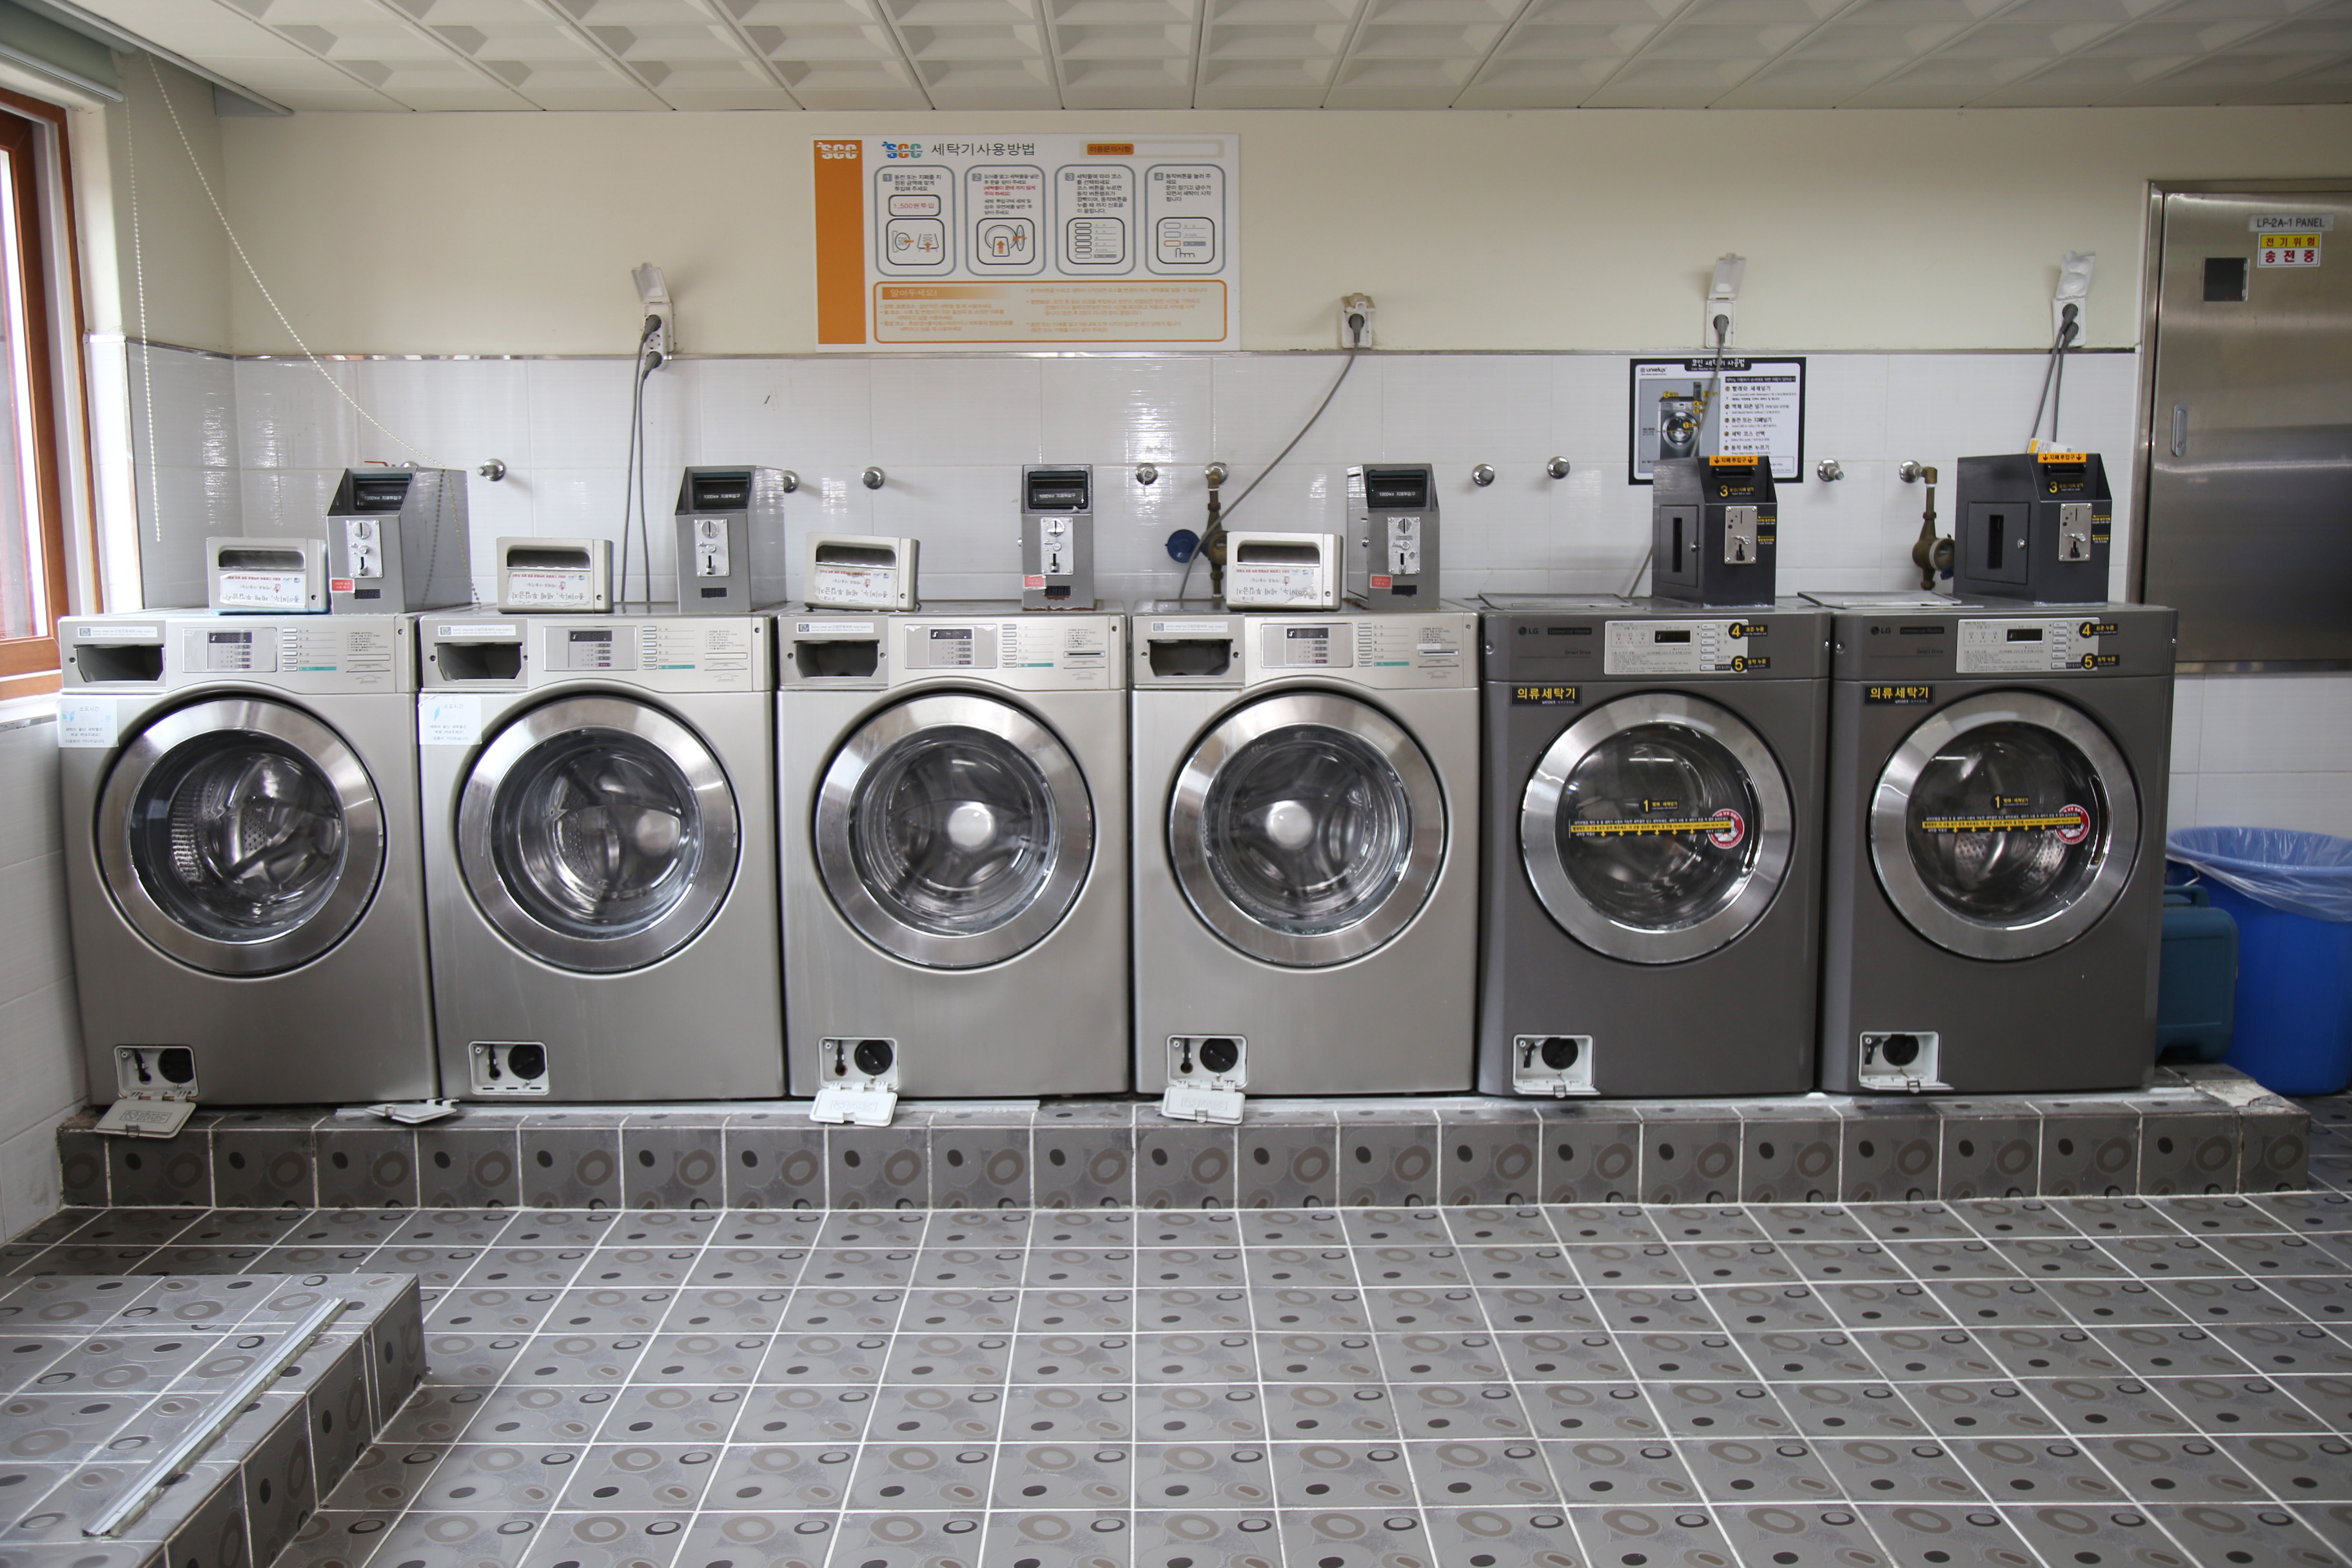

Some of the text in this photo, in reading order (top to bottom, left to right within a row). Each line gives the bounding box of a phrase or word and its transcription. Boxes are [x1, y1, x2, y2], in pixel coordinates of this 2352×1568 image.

[820, 143, 858, 159] SCC
[887, 143, 922, 159] SCC
[931, 142, 1035, 156] 세탁기사용방법
[2257, 218, 2324, 228] LP-2A-1 PANEL
[1691, 358, 1703, 368] 코인
[1727, 358, 1745, 368] 사용법
[1720, 485, 1729, 497] 3
[2049, 481, 2057, 493] 3
[512, 591, 538, 600] 투입금지
[818, 587, 844, 595] 투입금지
[1237, 587, 1262, 595] 투입금지
[1731, 625, 1741, 637] 4
[2082, 623, 2091, 636] 4
[1734, 658, 1743, 671] 5
[2084, 655, 2093, 668] 5
[1517, 688, 1575, 700] 의류세탁기
[1870, 687, 1928, 699] 의류세탁기
[1643, 799, 1649, 812] 1
[1995, 796, 2000, 808] 1
